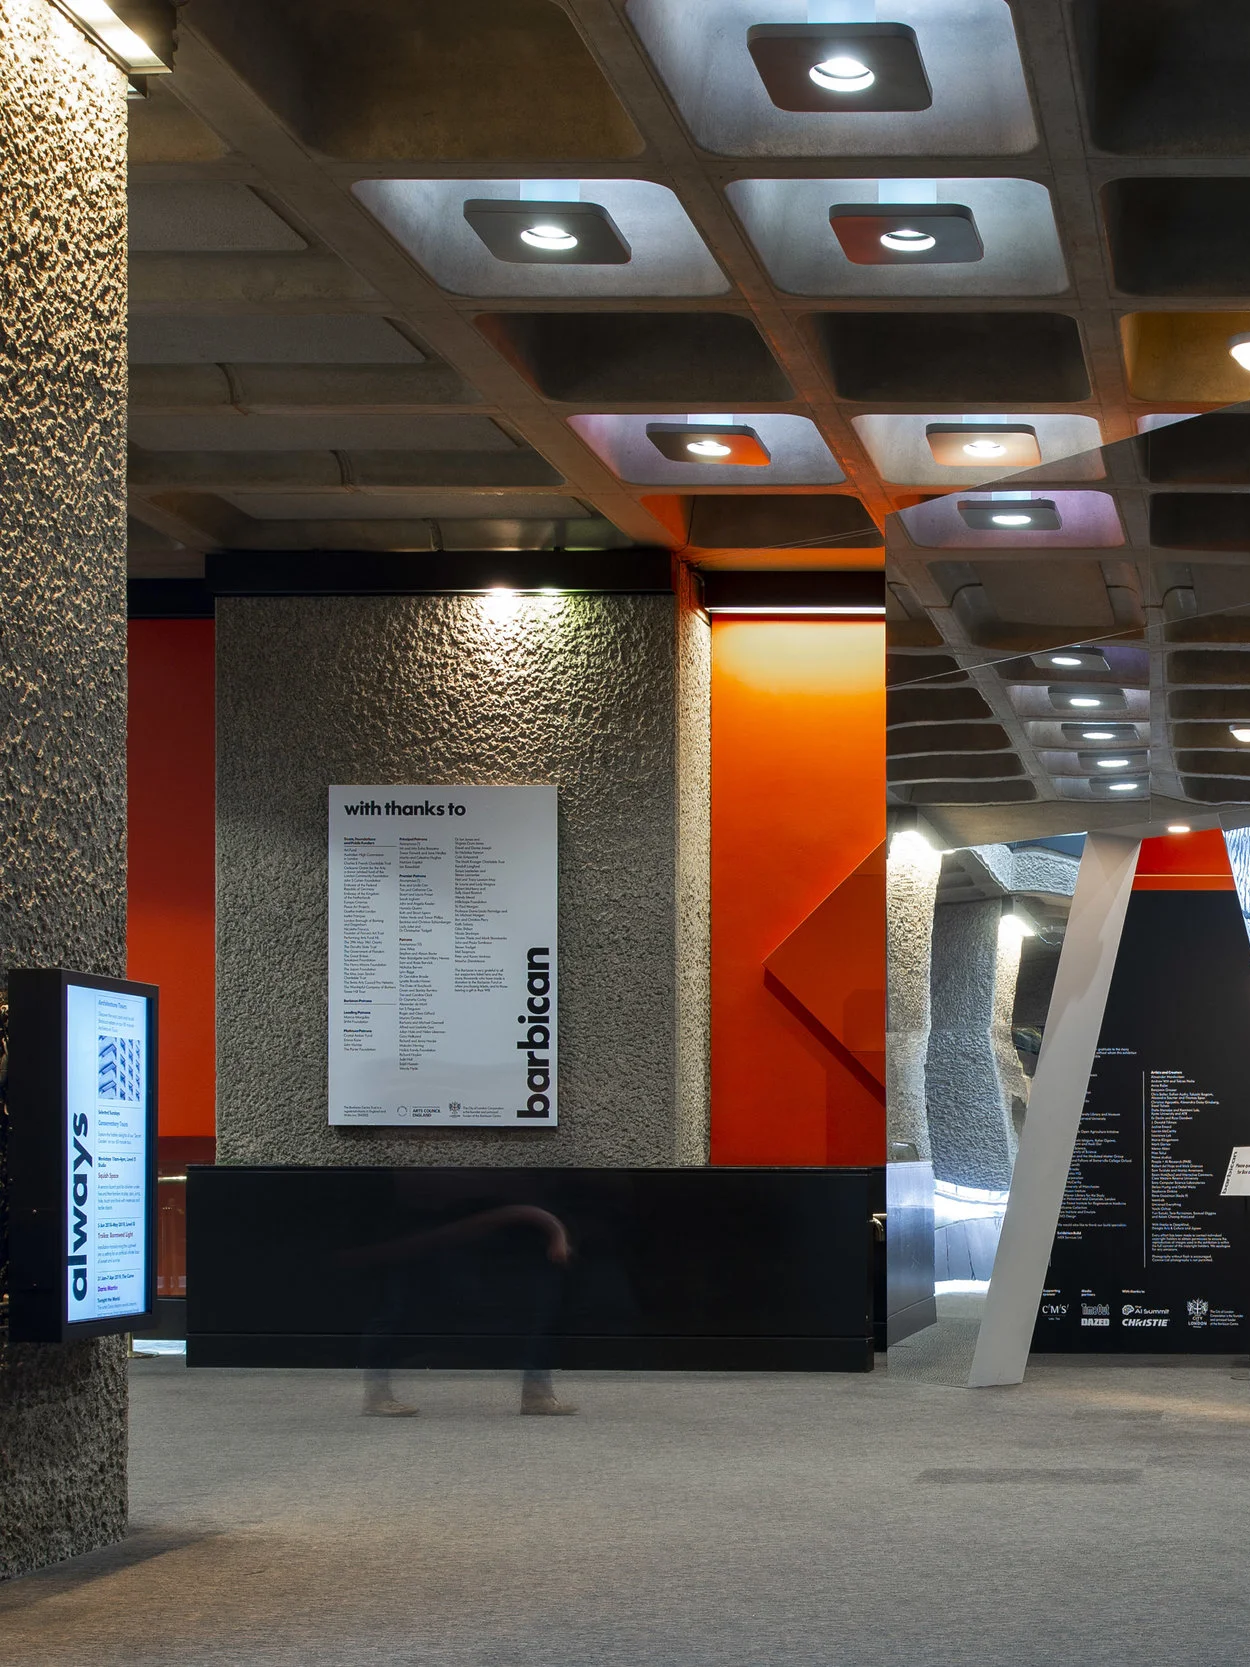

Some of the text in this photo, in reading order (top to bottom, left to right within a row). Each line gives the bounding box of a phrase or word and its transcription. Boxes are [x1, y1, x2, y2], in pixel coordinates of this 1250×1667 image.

[345, 800, 466, 816] with thanks to
[517, 947, 549, 1119] barbican
[1222, 1151, 1237, 1194] barbican
[68, 1113, 92, 1302] always
[1081, 1318, 1109, 1326] DAZED
[1122, 1318, 1168, 1327] CHRISTIE
